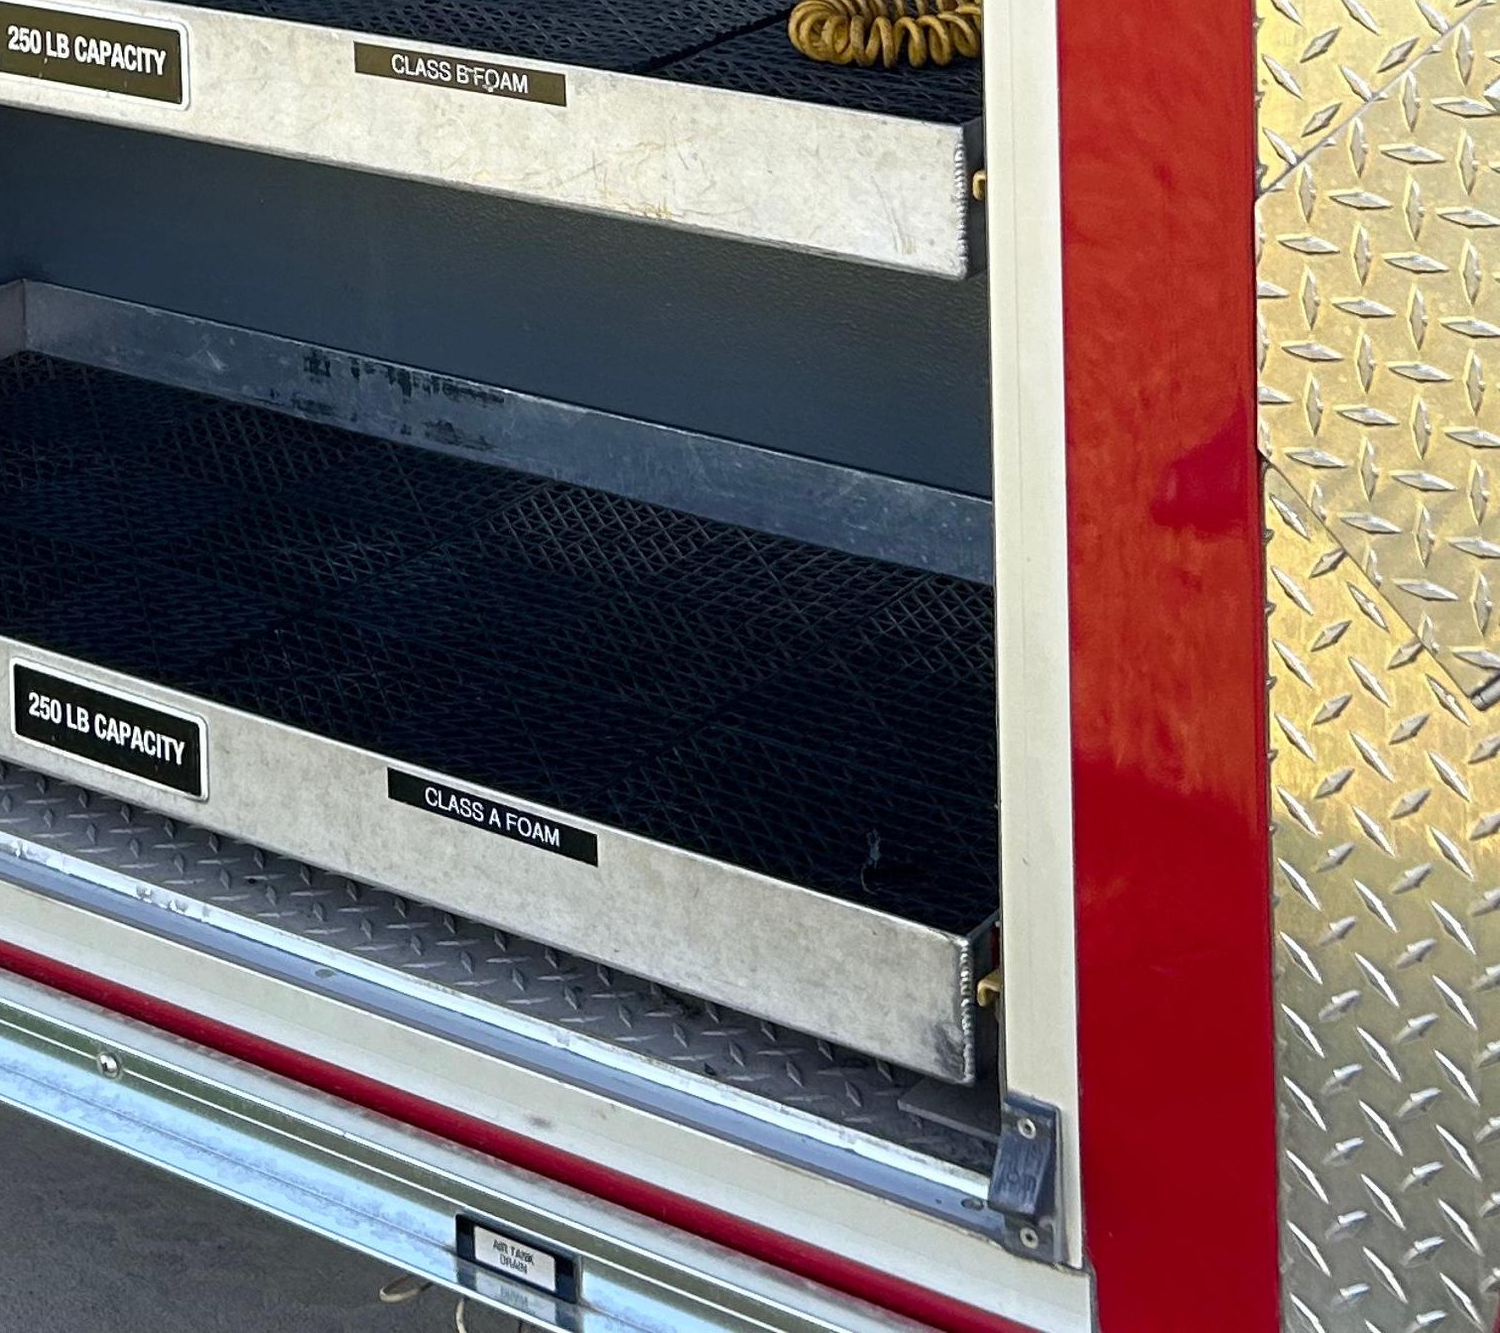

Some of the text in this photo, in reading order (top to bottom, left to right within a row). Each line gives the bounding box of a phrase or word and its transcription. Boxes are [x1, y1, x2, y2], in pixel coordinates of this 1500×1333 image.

[7, 25, 166, 76] 250 LB CAPACITY
[391, 54, 529, 94] CLASS B FOAM
[28, 692, 186, 765] 250 LB CAPACITY
[425, 787, 560, 847] CLASS A FOAM
[493, 1240, 508, 1253] AIR
